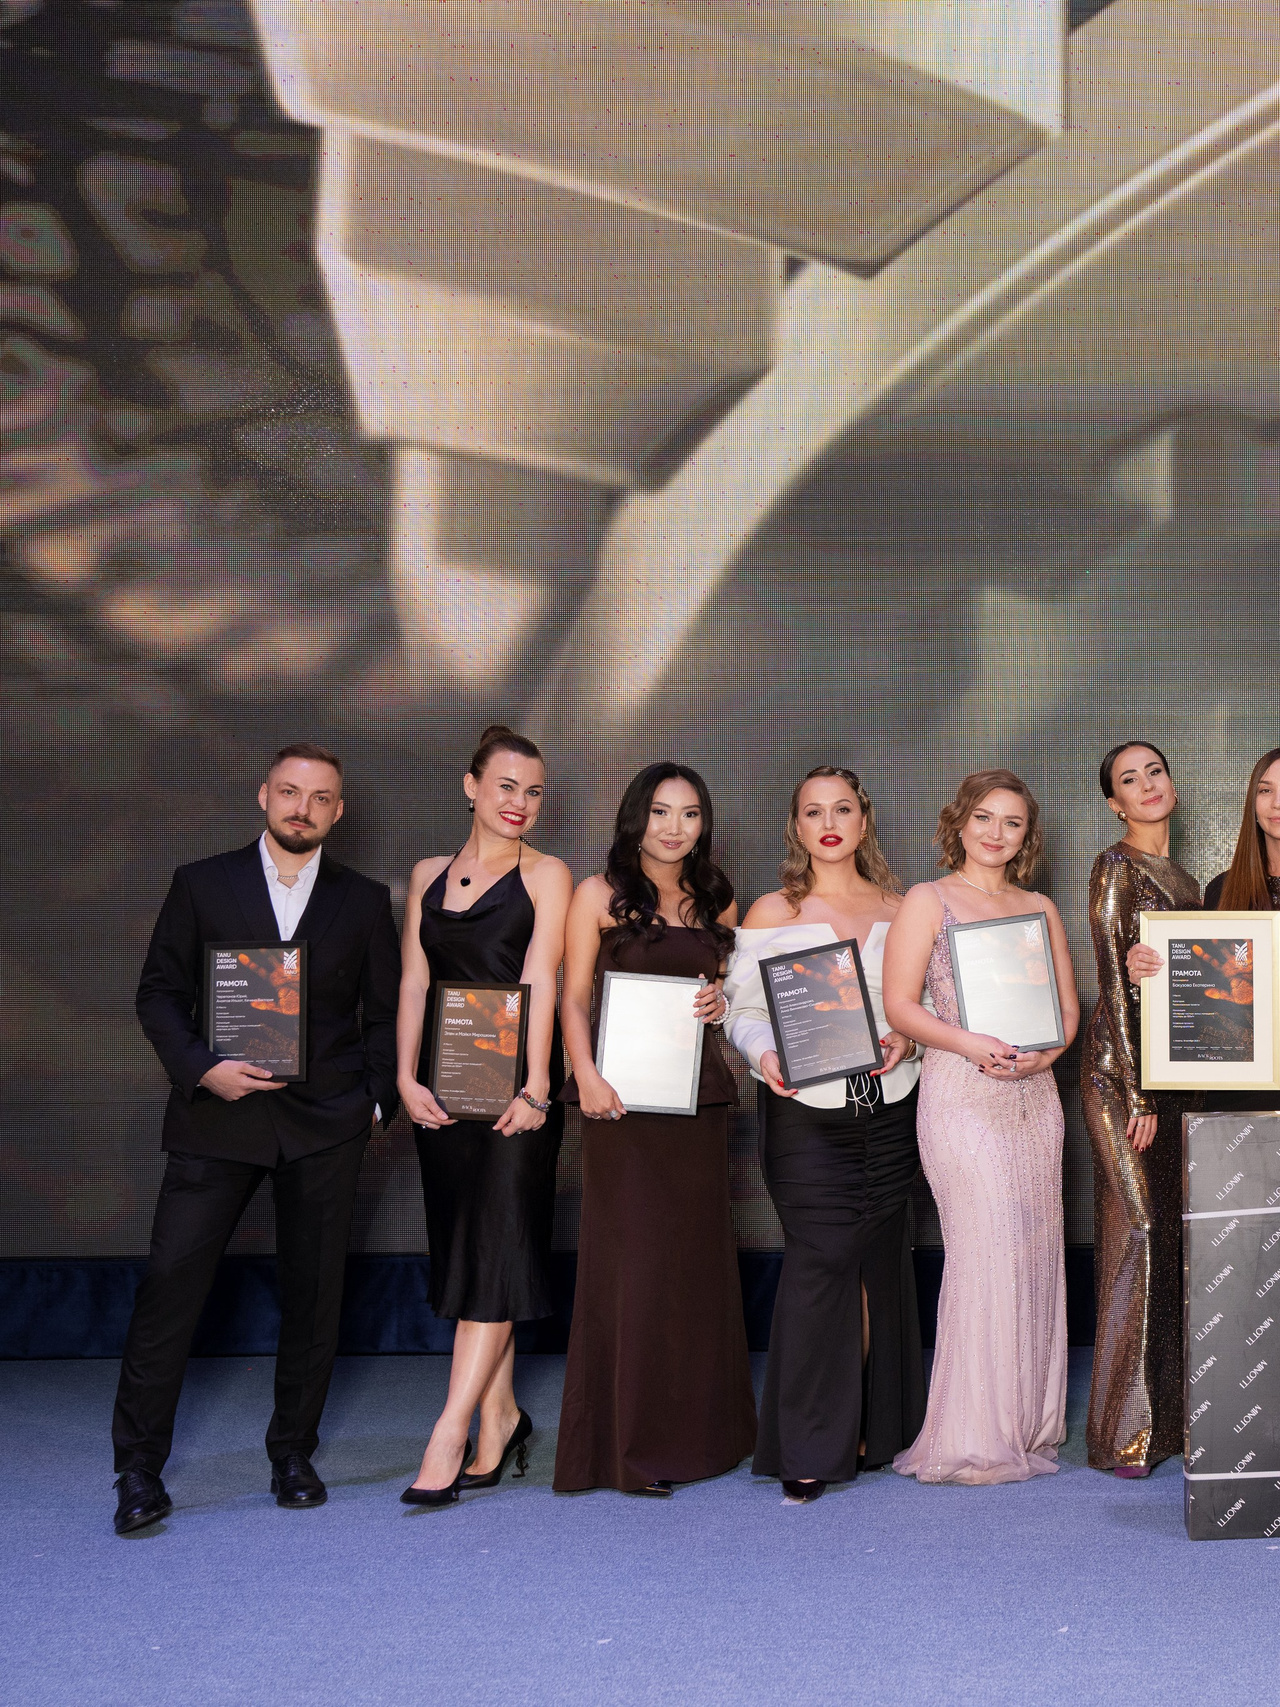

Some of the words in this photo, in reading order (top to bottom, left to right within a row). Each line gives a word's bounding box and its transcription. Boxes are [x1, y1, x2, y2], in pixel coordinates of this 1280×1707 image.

[773, 970, 792, 978] DESIGN
[774, 975, 794, 983] AWARD
[777, 987, 808, 999] ГРАМОТА
[1226, 1124, 1255, 1152] MINOTTI
[1216, 1171, 1244, 1200] MINOTTI
[1211, 1218, 1240, 1247] MINOTTI
[1206, 1264, 1234, 1293] MINOTTI
[1195, 1312, 1224, 1341] MINOTTI
[1246, 1316, 1274, 1346] MINOTTI
[1190, 1355, 1217, 1384] MINOTTI
[1239, 1360, 1268, 1389] MINOTTI
[1234, 1404, 1262, 1434] MINOTTI
[1217, 1498, 1246, 1528] MINOTTI
